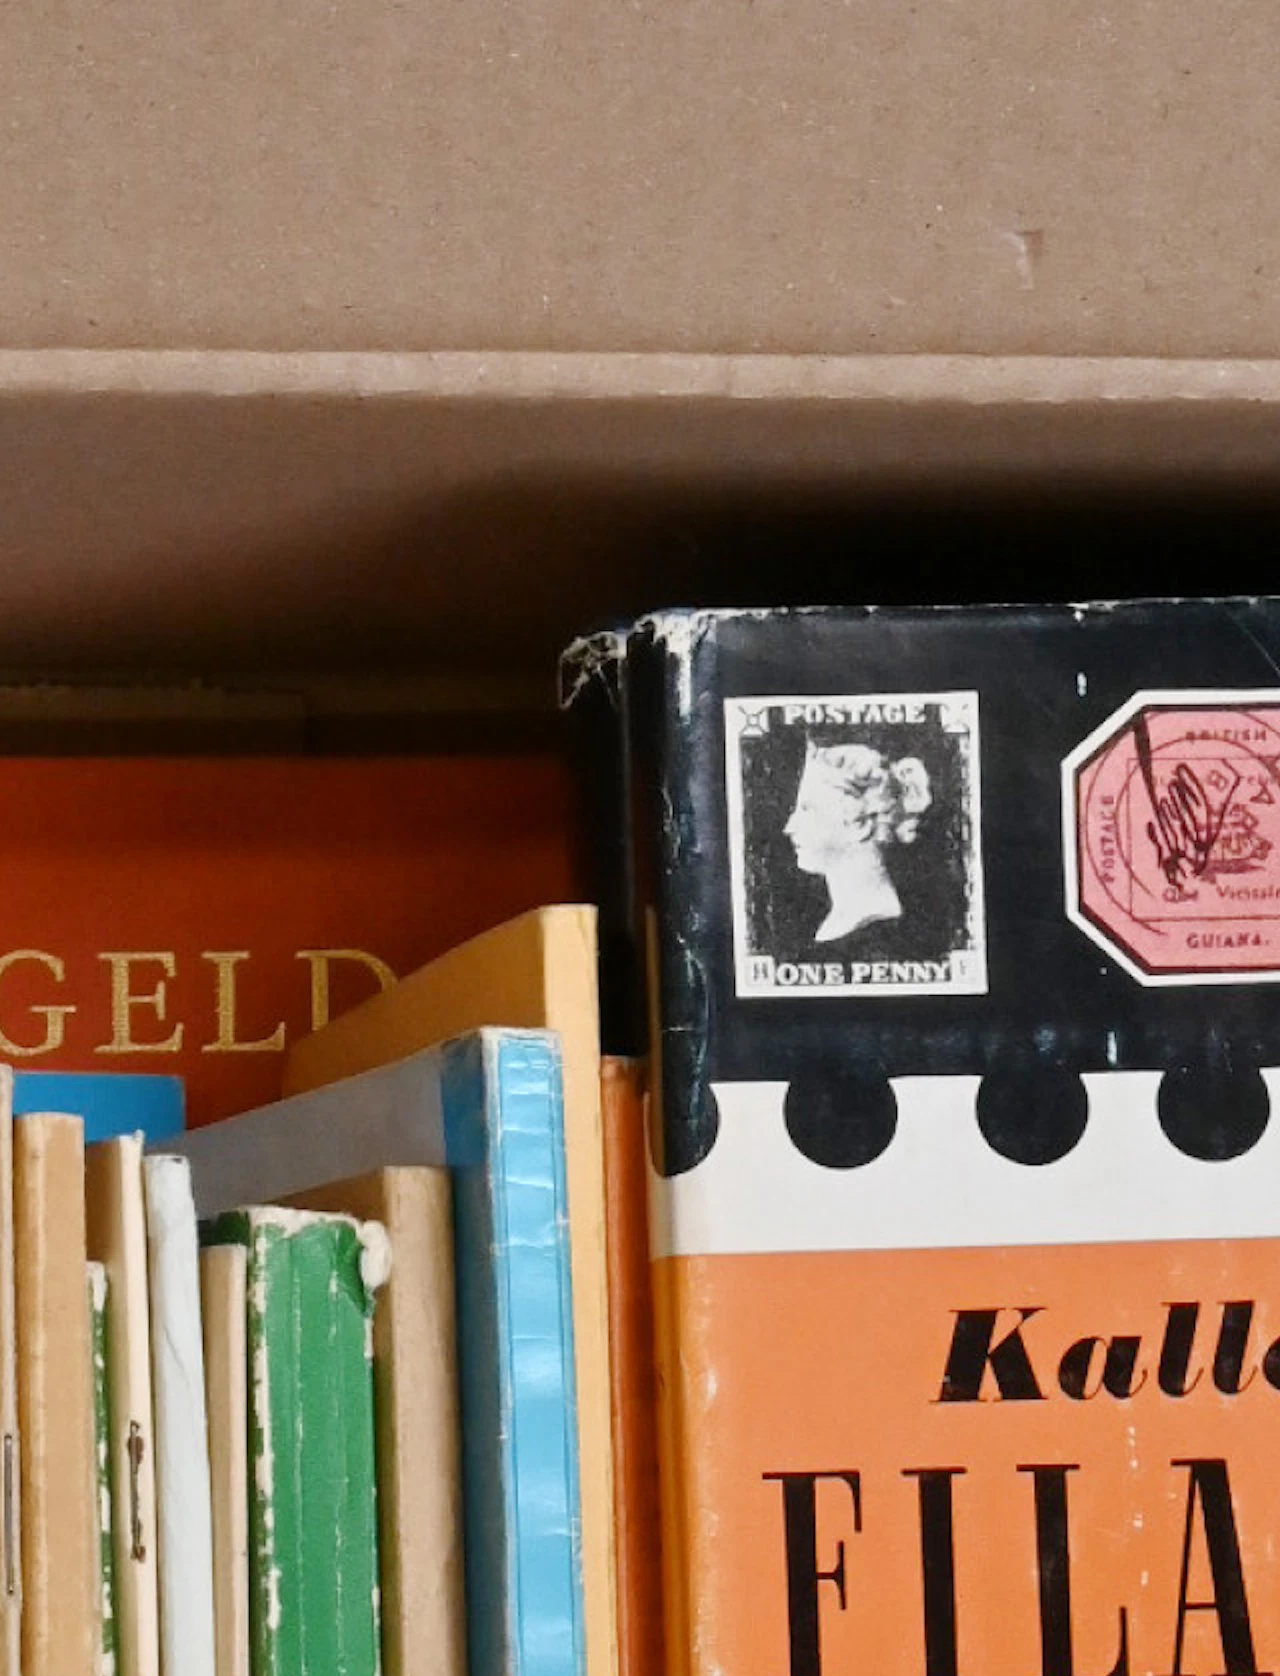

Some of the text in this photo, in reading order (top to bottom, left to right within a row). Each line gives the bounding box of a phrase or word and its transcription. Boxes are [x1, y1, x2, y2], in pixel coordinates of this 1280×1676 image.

[782, 702, 926, 726] POSTAGE
[777, 960, 846, 986] ONE
[851, 958, 952, 985] PENNY
